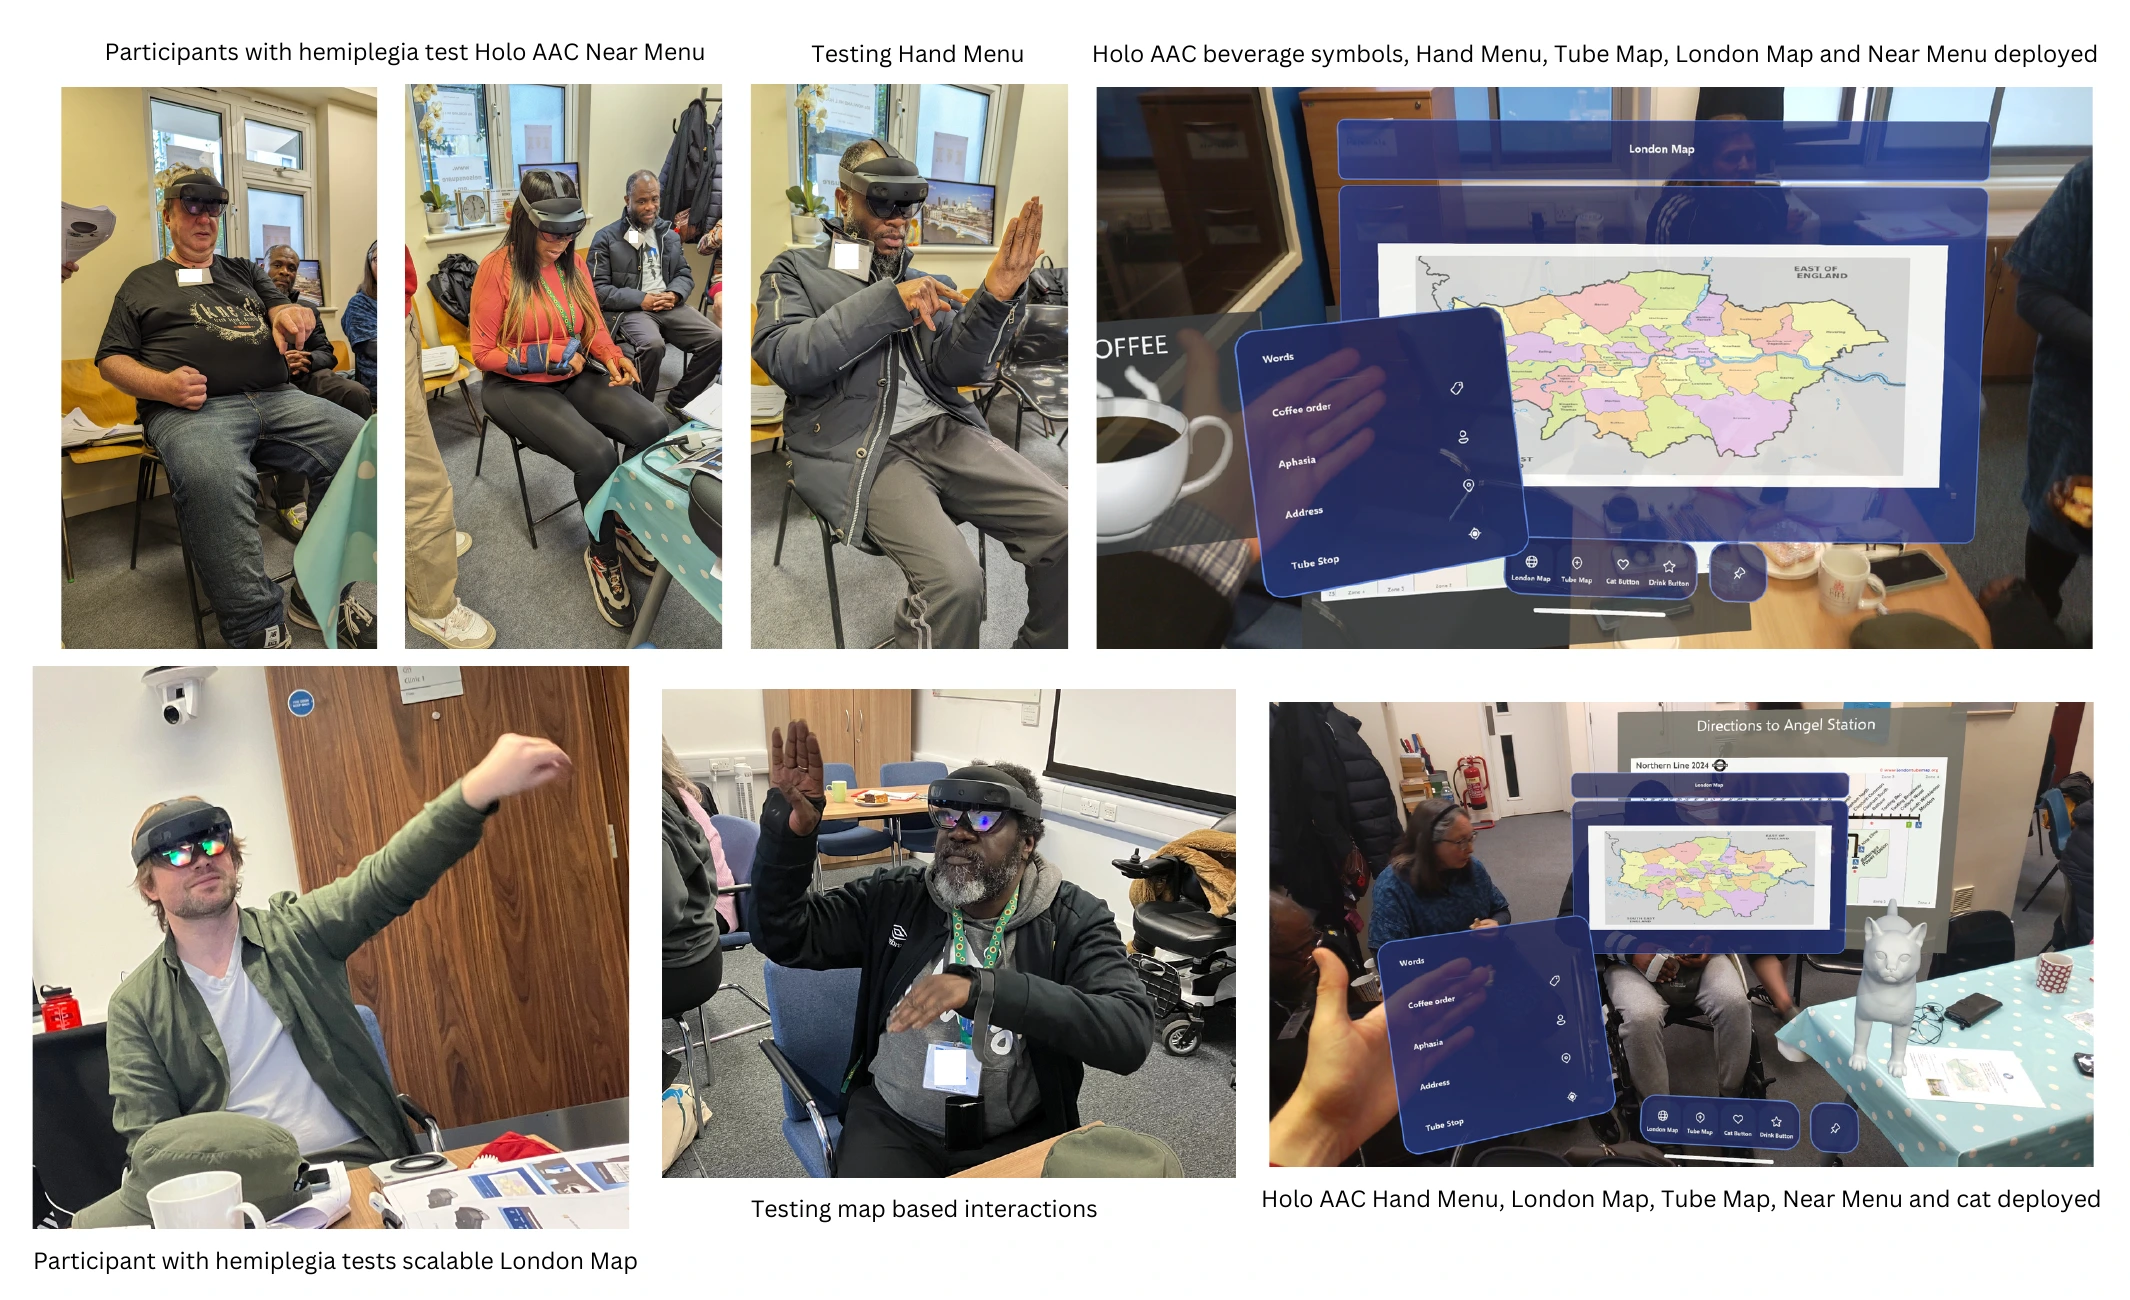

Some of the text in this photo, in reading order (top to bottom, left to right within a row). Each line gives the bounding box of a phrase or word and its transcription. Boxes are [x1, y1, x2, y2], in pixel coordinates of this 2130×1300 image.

[1629, 144, 1695, 157] London Map
[1096, 335, 1168, 359] OFFEE
[1262, 352, 1294, 364] Words
[1272, 402, 1332, 417] Coffee order
[1278, 456, 1317, 470] Aphasia
[1285, 507, 1324, 519] Address
[1291, 556, 1340, 570] Tube Stop
[1511, 574, 1551, 583] London Map
[1618, 578, 1640, 586] Button
[1648, 579, 1690, 587] Drink Button
[1697, 718, 1876, 734] Directions to Angel Station
[1636, 761, 1671, 769] Northern
[1673, 761, 1690, 769] Line
[1399, 957, 1425, 967] Words
[1407, 996, 1456, 1009] Coffee order
[1413, 1039, 1444, 1051] Aphasia
[1420, 1080, 1450, 1091] Address
[1425, 1118, 1464, 1132] Tube Stop
